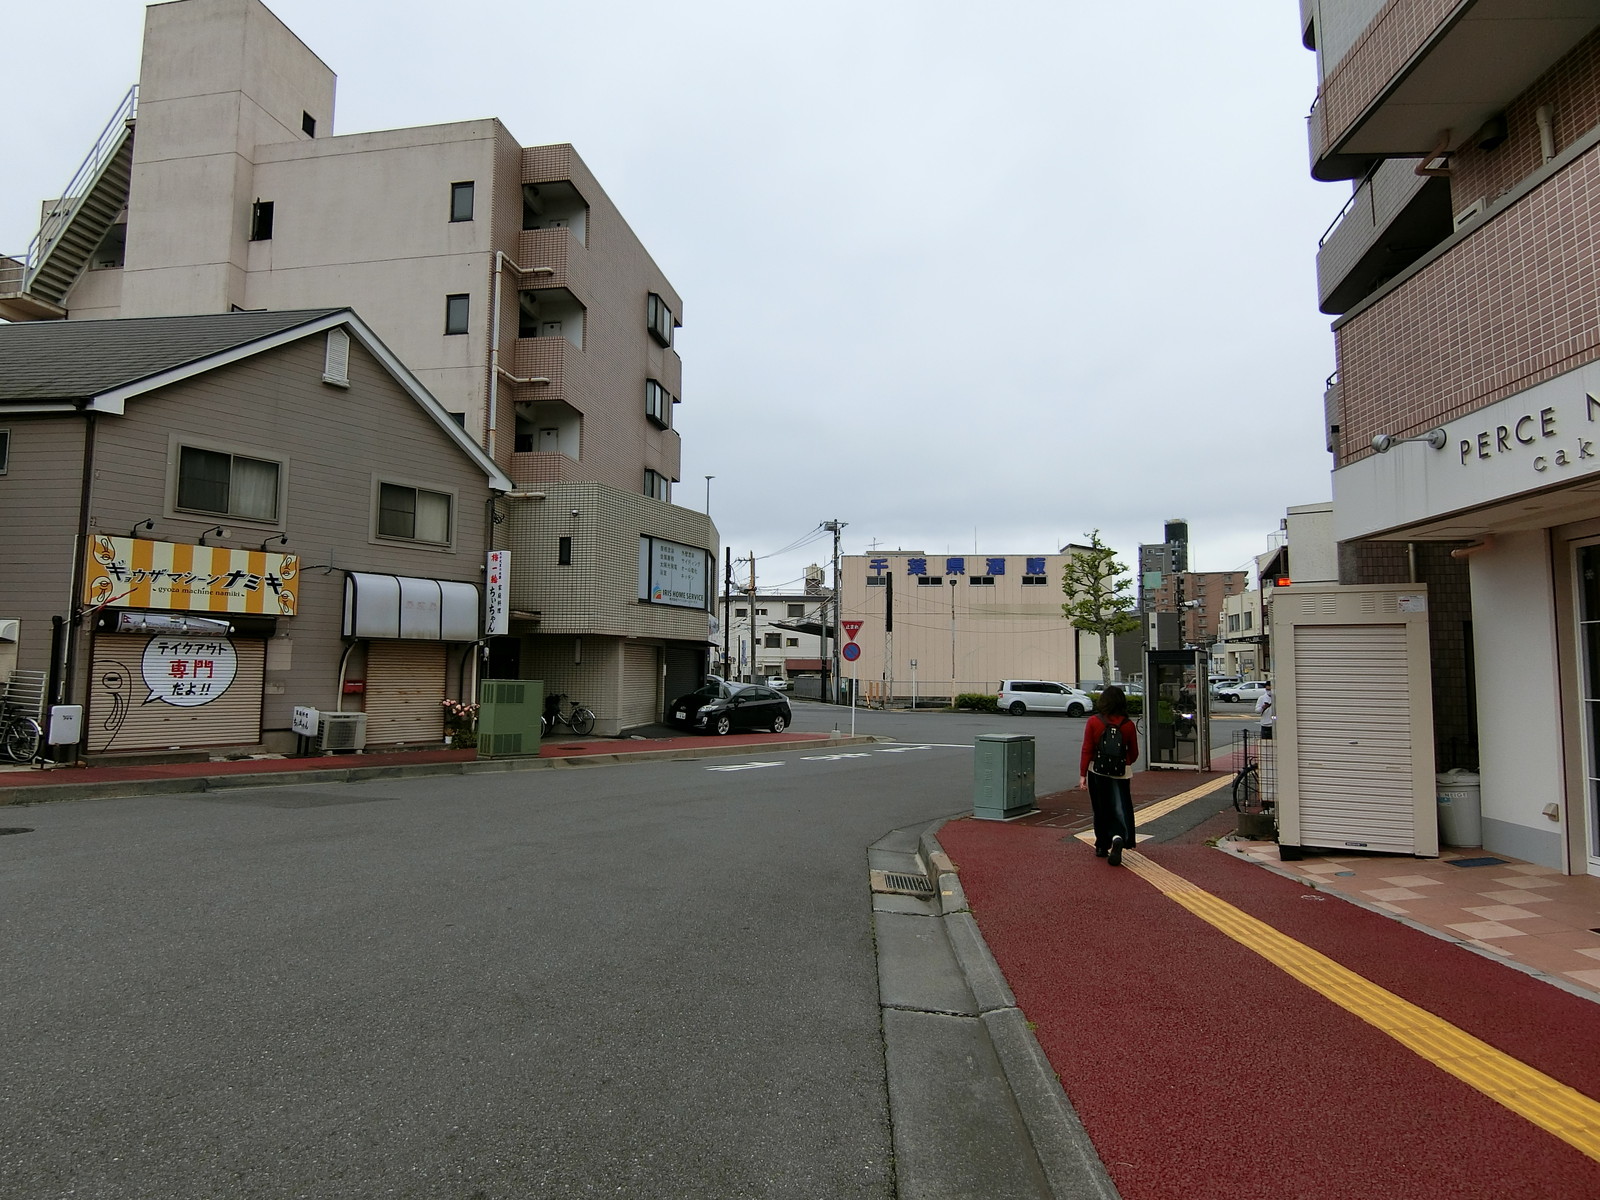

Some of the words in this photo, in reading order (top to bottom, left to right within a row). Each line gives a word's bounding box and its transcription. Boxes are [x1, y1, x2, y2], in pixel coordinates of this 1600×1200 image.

[1460, 406, 1558, 466] PERCE
[869, 557, 1046, 576] 千葉県酒販
[158, 585, 180, 594] gyoza
[181, 587, 213, 596] machine
[215, 589, 240, 597] namiki
[686, 593, 704, 601] SERVICE
[158, 641, 228, 656] テイクアウト
[168, 659, 214, 679] 専門
